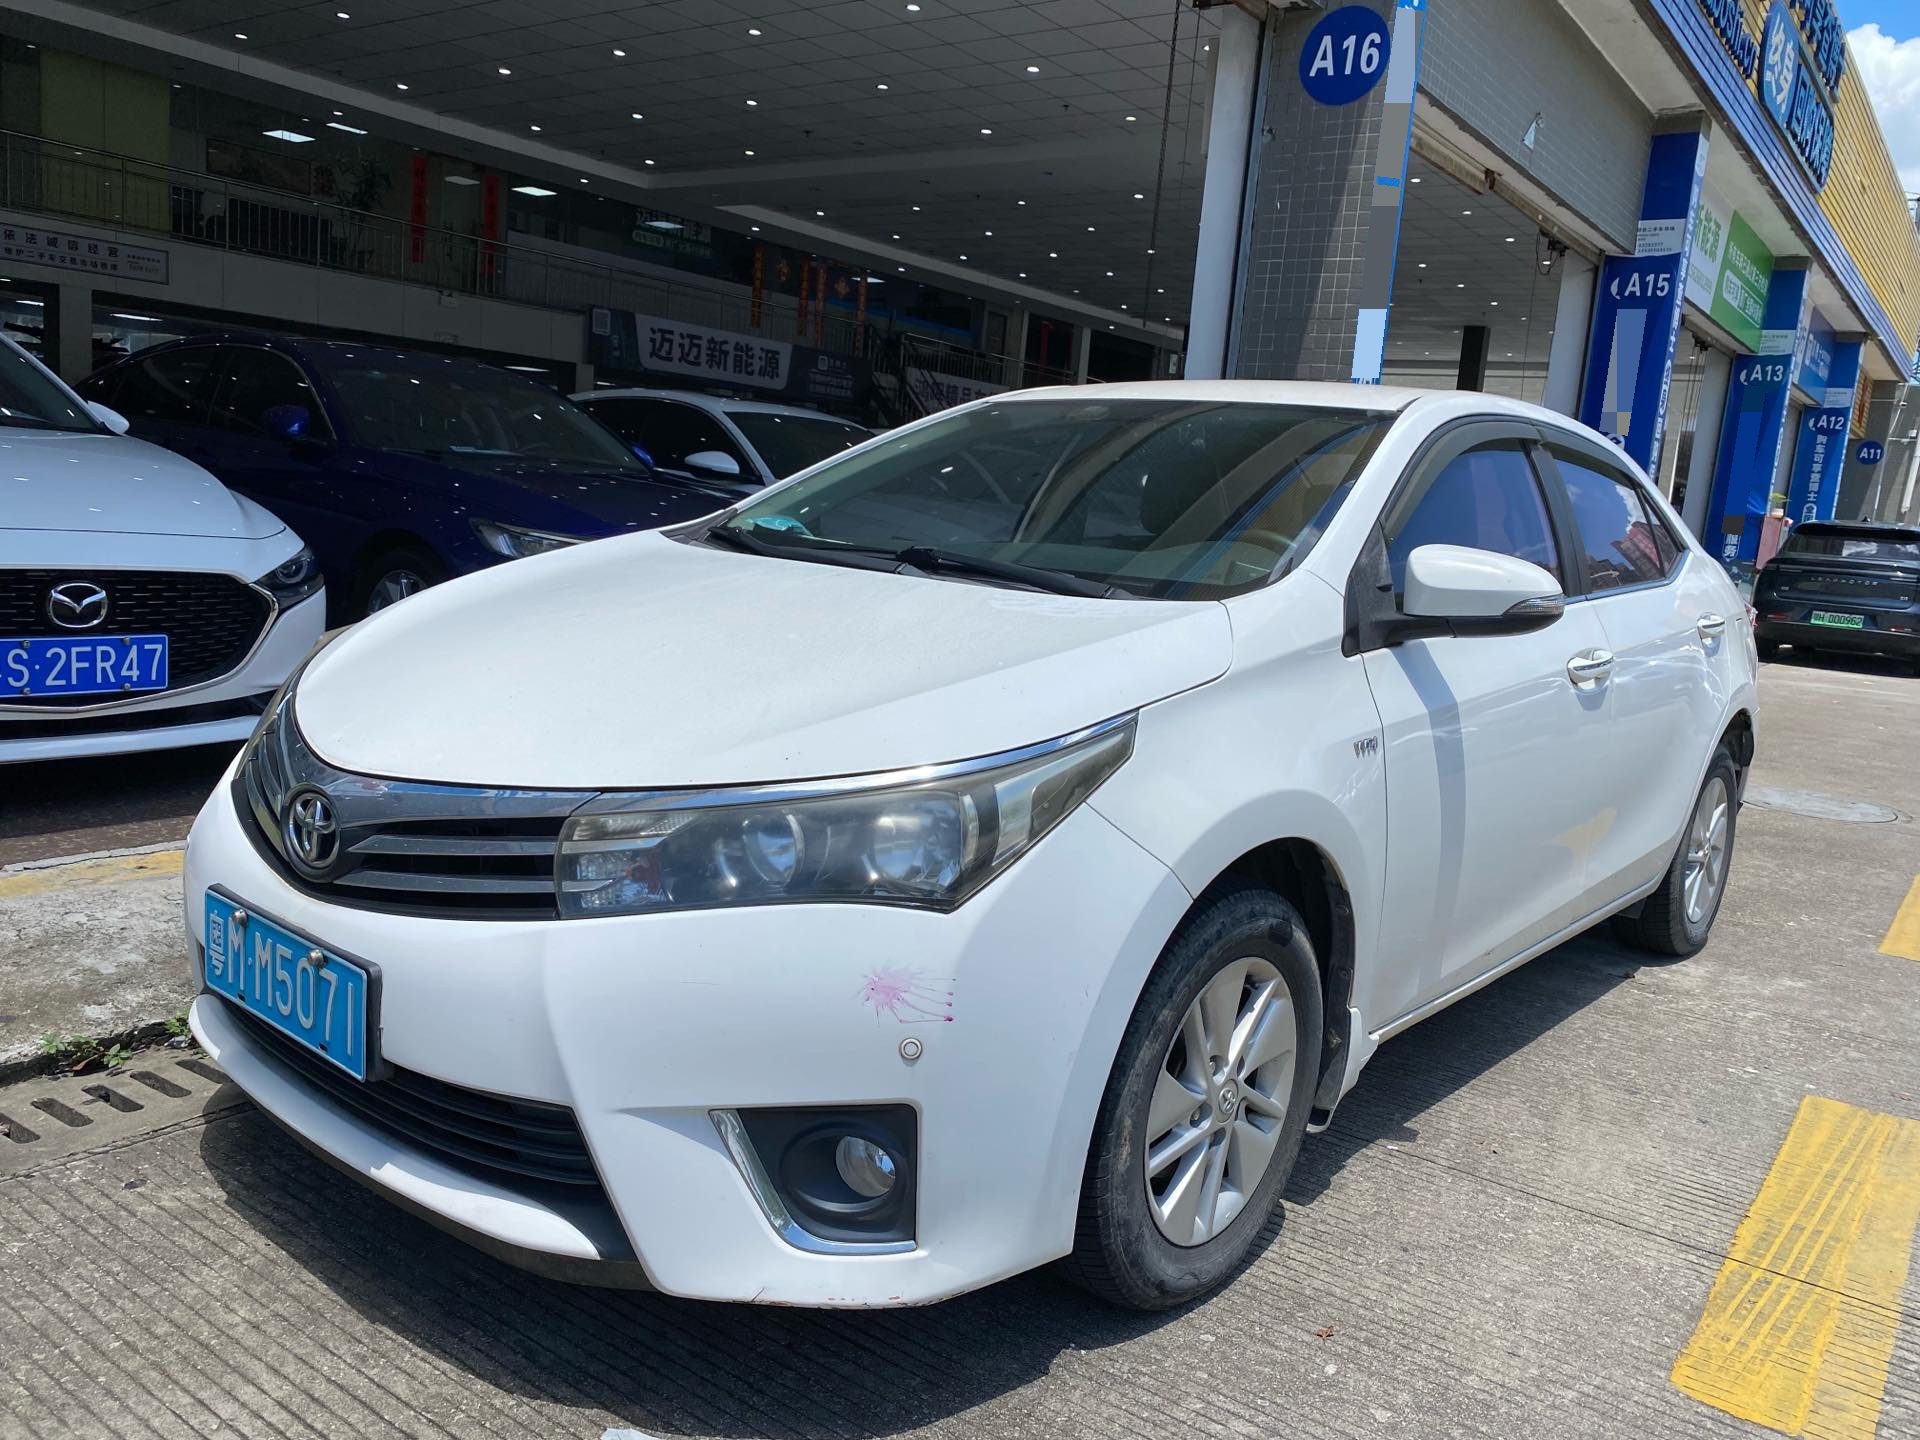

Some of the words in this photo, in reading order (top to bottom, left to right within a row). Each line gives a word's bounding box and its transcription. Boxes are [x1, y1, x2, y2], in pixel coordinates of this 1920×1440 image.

[1309, 32, 1381, 77] A16
[1624, 272, 1670, 297] A15
[649, 326, 782, 379] 迈迈新能源
[1750, 364, 1784, 382] A13
[1817, 415, 1845, 430] A12
[1860, 447, 1882, 459] A11
[0, 644, 163, 688] S·2FR47
